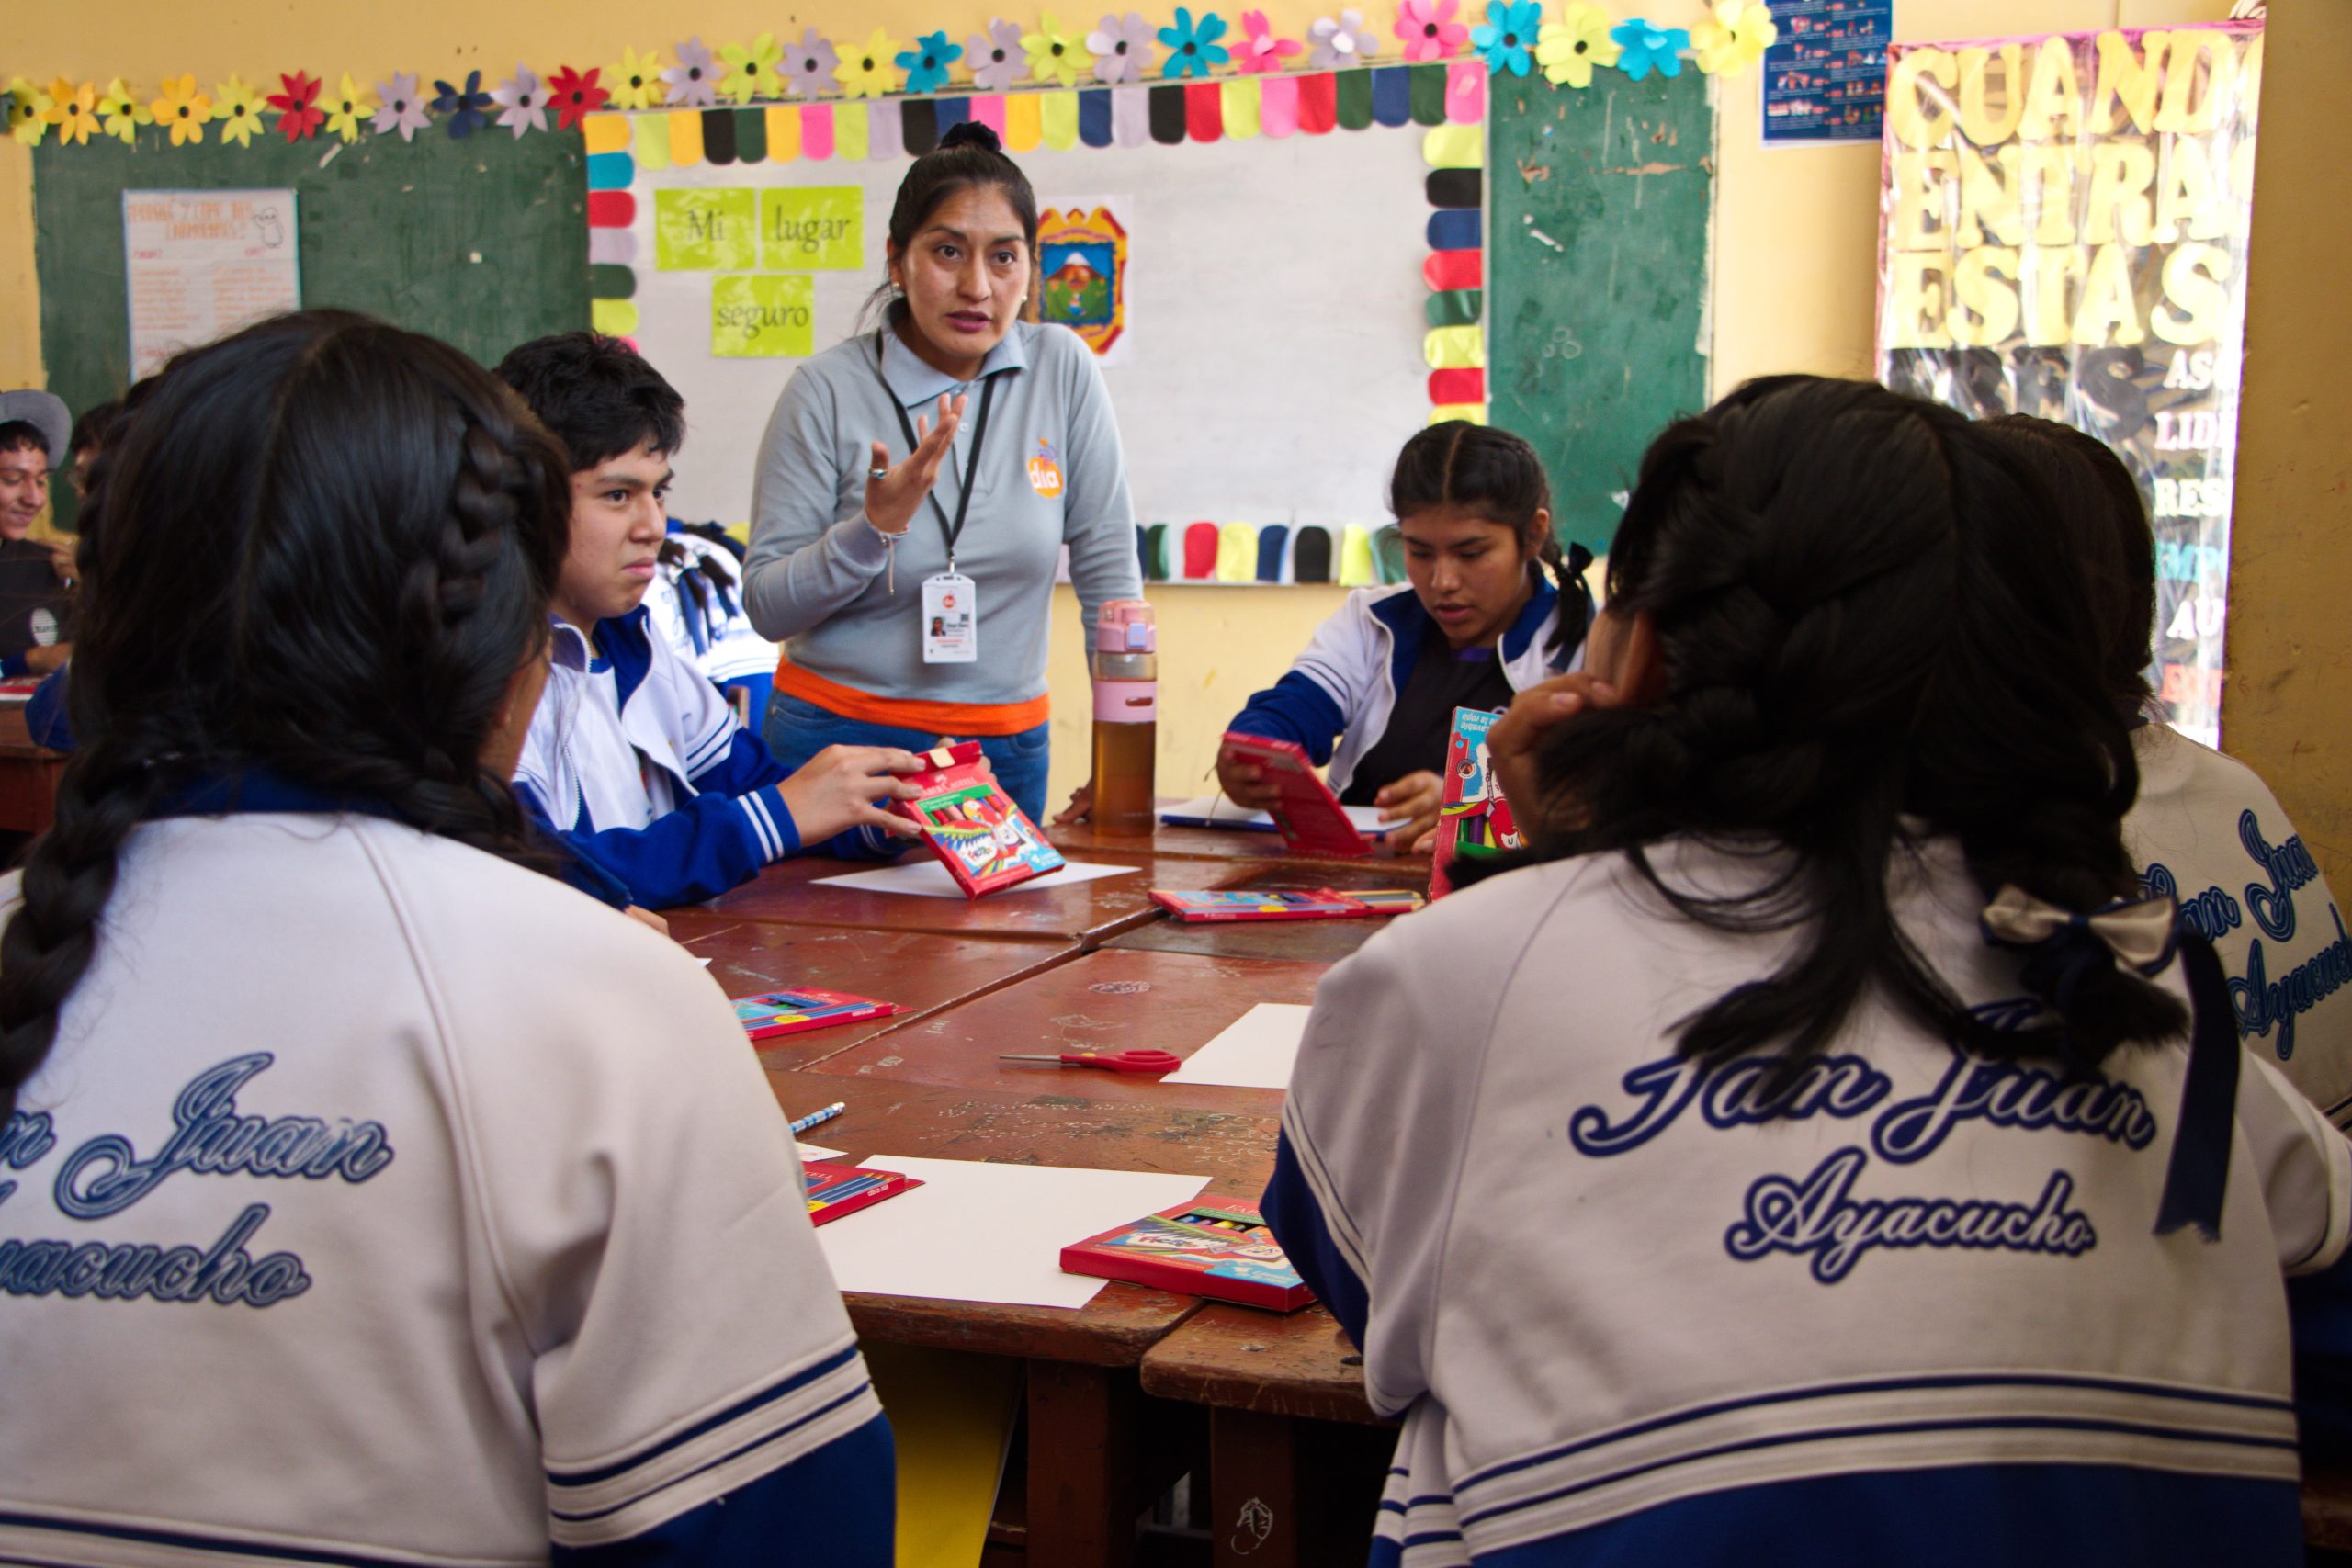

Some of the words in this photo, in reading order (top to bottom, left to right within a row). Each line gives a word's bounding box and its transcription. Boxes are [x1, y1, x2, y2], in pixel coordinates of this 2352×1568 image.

[1892, 30, 2263, 148] CUAND
[687, 208, 725, 241] Mi
[775, 204, 851, 254] lugar
[717, 304, 809, 340] seguro
[53, 1051, 395, 1220] Juan
[1724, 1145, 2098, 1285] Ayacucho
